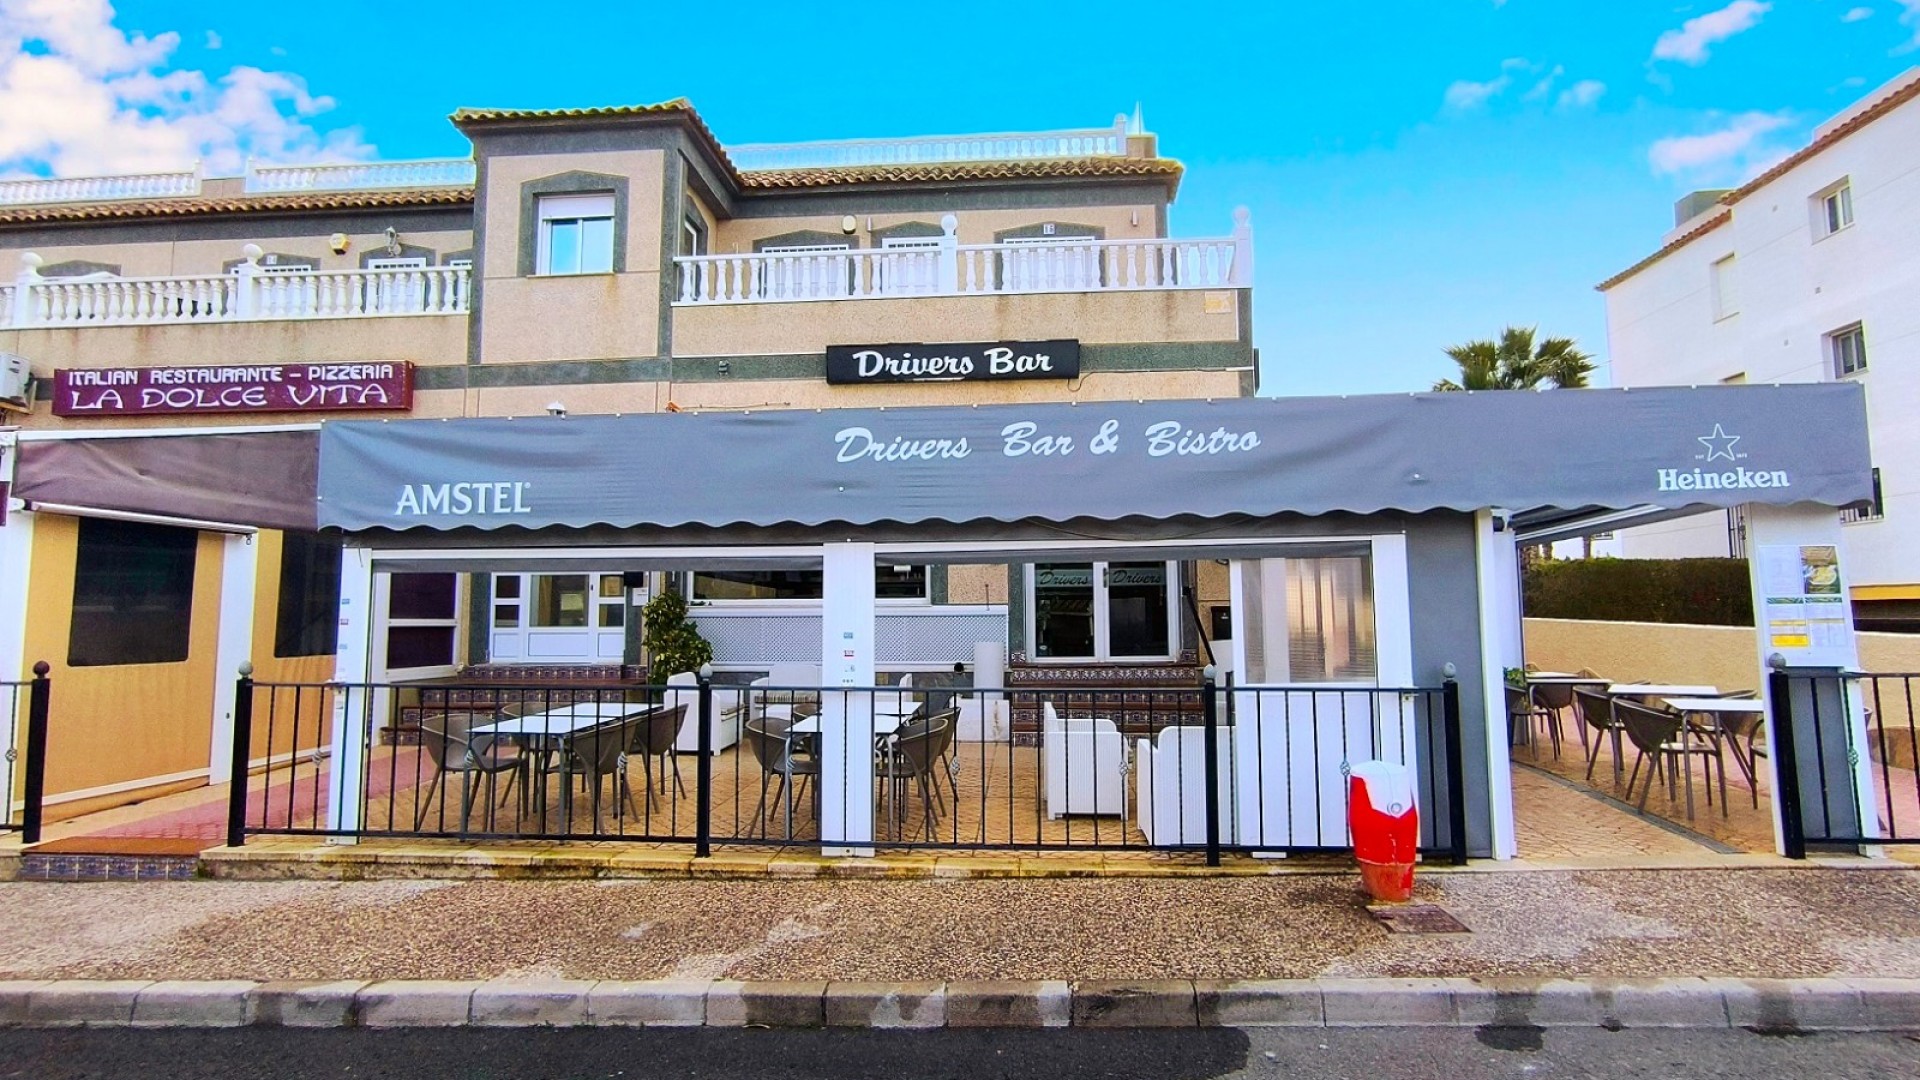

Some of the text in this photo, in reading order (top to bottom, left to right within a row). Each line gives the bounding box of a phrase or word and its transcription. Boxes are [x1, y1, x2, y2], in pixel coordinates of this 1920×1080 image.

[852, 346, 1054, 378] Drivers Bar
[68, 370, 138, 386] ITALIAN
[151, 367, 283, 384] RESTAURANTE
[308, 364, 393, 381] PIZZERIA
[71, 383, 388, 409] LA DOLCE VITA
[834, 419, 1261, 463] Drivers Bar & Bistro
[1657, 466, 1790, 491] Heineken
[395, 482, 531, 515] AMSTEL
[1040, 571, 1088, 585] Drivers
[1112, 569, 1161, 584] Drivers
